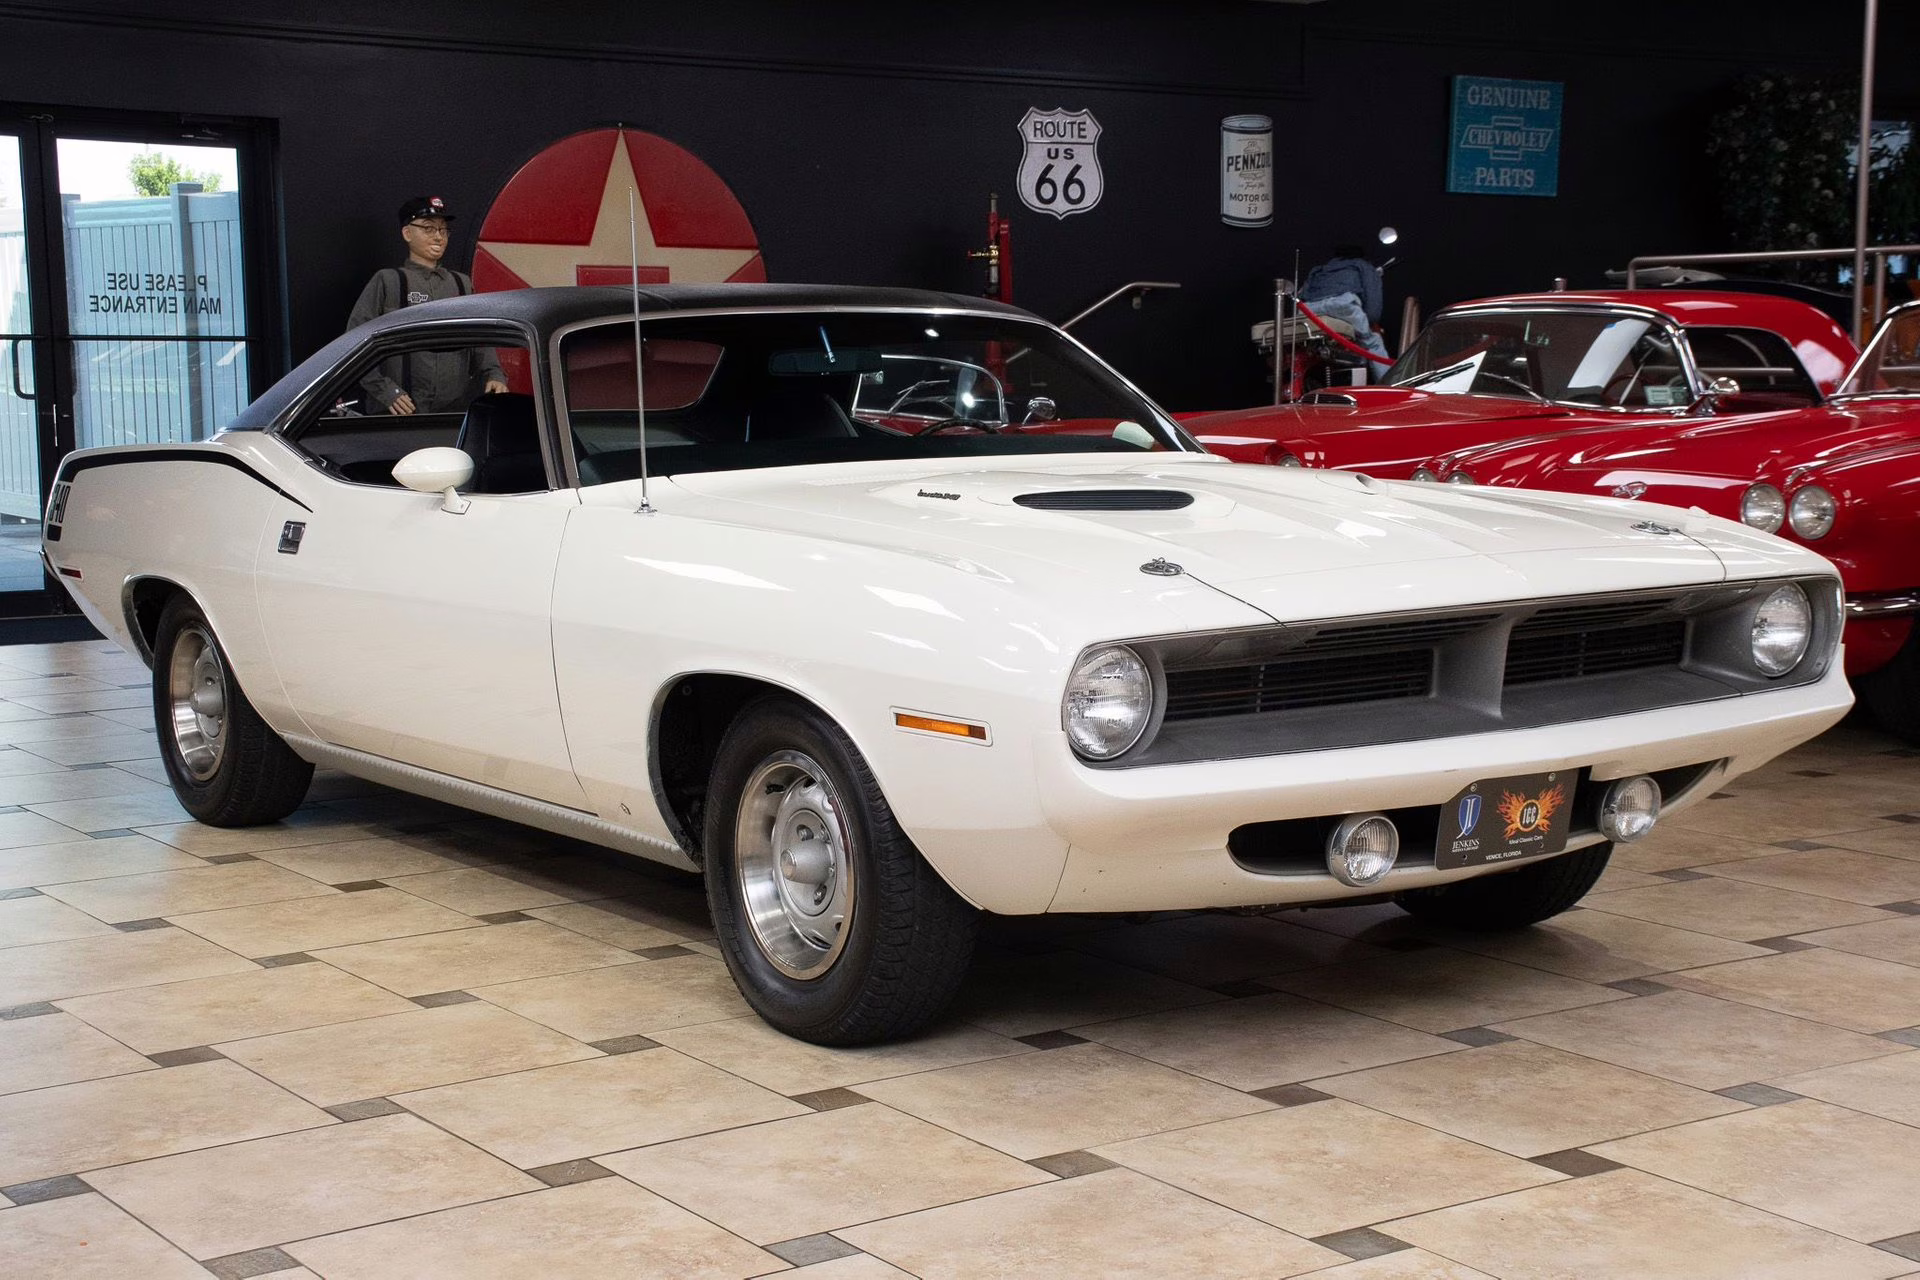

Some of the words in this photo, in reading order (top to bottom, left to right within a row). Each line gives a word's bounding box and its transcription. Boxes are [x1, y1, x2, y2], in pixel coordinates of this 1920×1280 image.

[1467, 85, 1551, 110] GENUINE
[1033, 120, 1087, 139] ROUTE
[1468, 128, 1547, 148] CHEVROLET
[1047, 148, 1075, 160] US
[1035, 163, 1085, 205] 66
[1474, 166, 1536, 188] PARTS
[1229, 192, 1260, 202] MOTOR
[1503, 850, 1522, 858] FLORIDA
